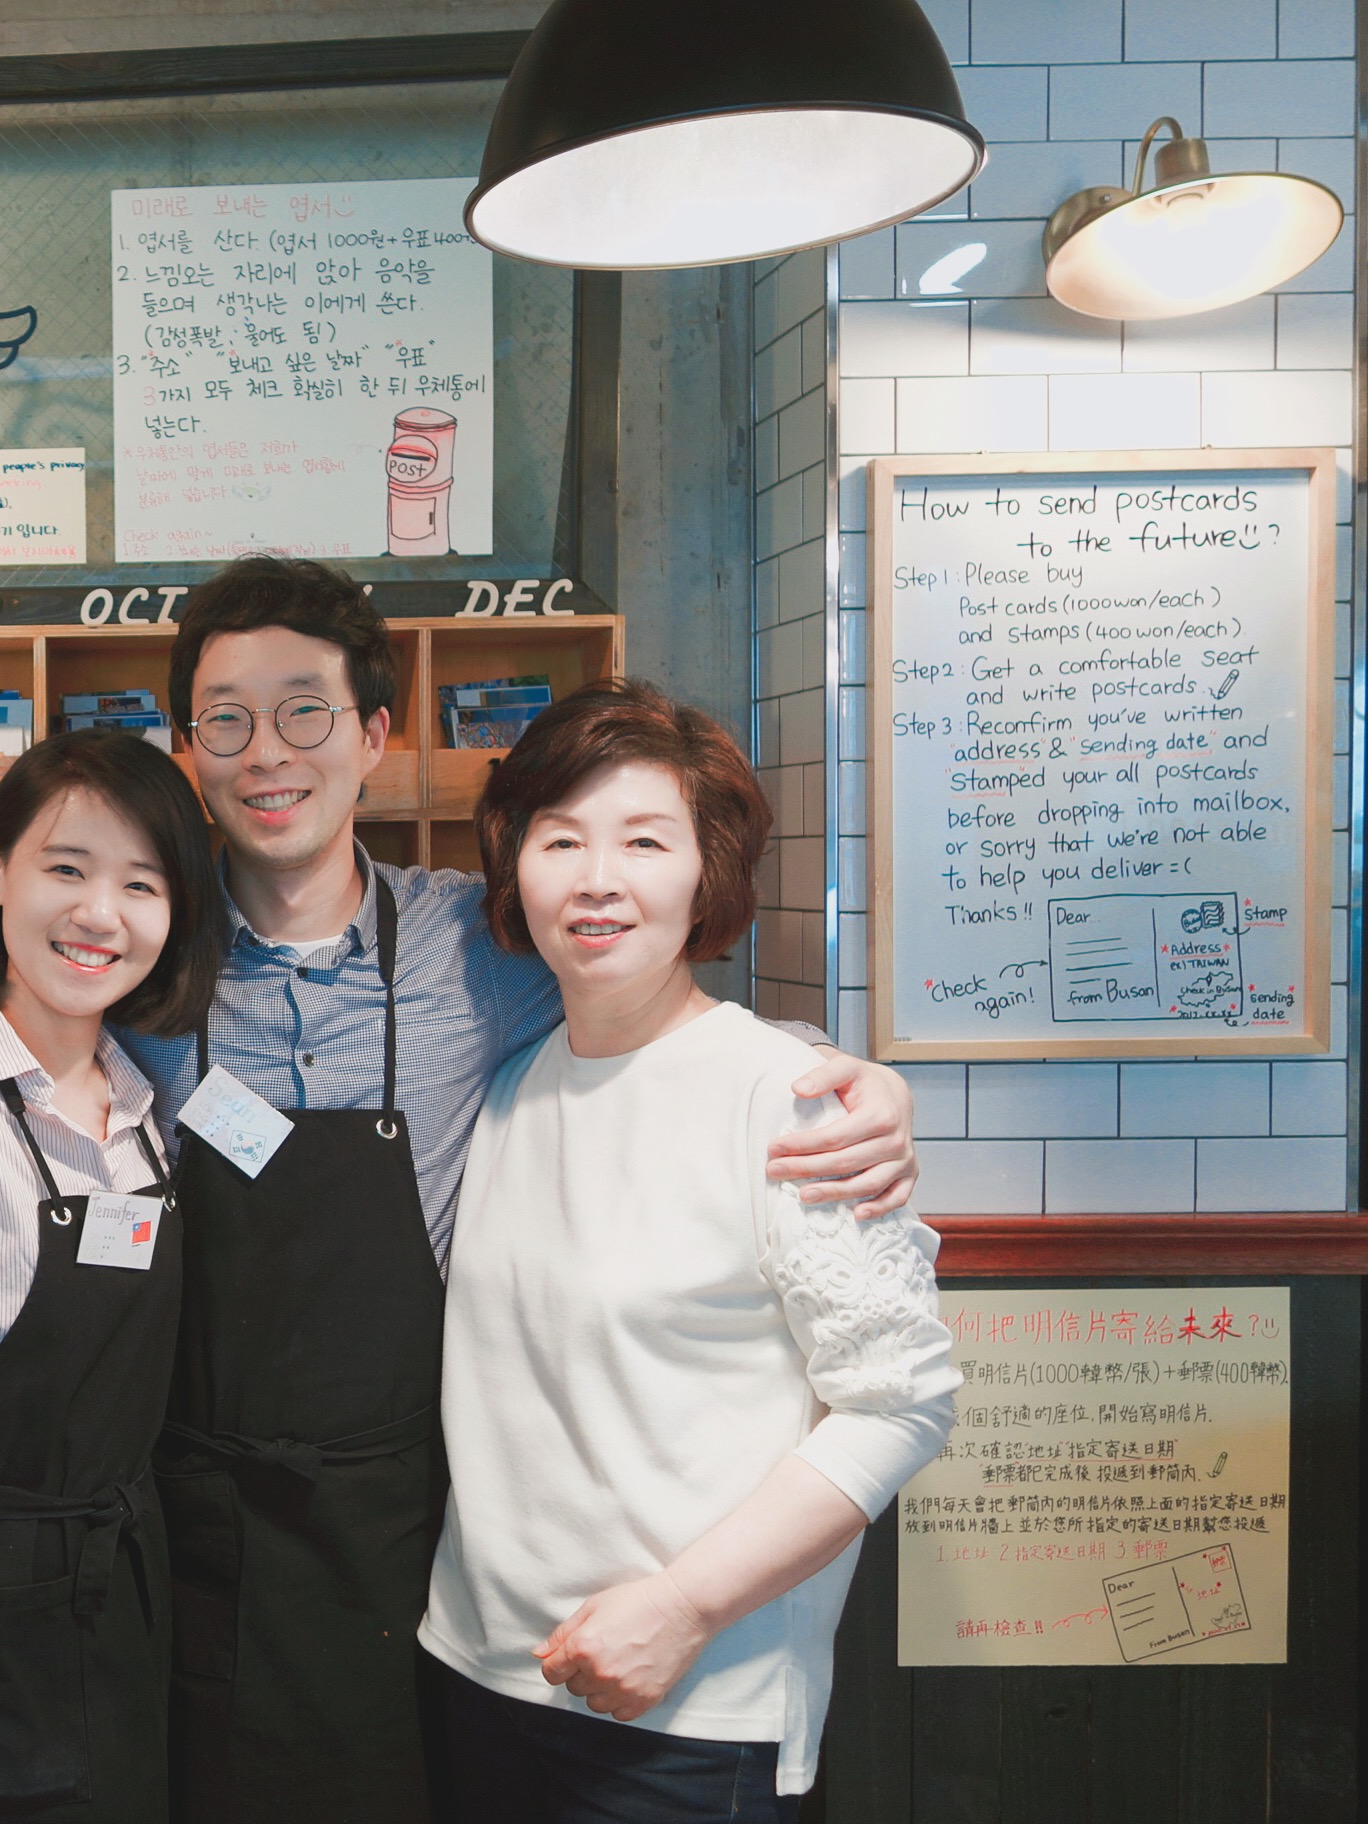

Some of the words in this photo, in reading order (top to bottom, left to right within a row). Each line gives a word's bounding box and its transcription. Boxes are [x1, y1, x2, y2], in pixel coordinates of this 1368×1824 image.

[133, 195, 193, 218] 미래로
[213, 194, 268, 217] 보내는
[289, 193, 331, 222] 엽서
[137, 230, 192, 255] 엽서를
[234, 262, 296, 285] 자리에
[316, 257, 362, 285] 앉아
[375, 258, 435, 284] 음악을
[142, 292, 195, 317] 들으며
[217, 292, 287, 316] 생각나는
[304, 292, 365, 314] 이에게
[286, 352, 316, 372] 싶은
[204, 378, 232, 400] 모두
[246, 378, 283, 398] 체크
[293, 374, 343, 399] 확실히
[359, 375, 380, 396] 한
[388, 378, 406, 395] 뒤
[415, 374, 485, 401] 우체통에
[900, 487, 969, 522] How
[985, 488, 1021, 516] to
[1038, 485, 1097, 515] send
[1115, 485, 1258, 523] postcards
[1016, 532, 1053, 558] to
[1068, 529, 1112, 554] the
[1129, 521, 1235, 553] future
[964, 562, 1030, 585] Please
[1047, 563, 1083, 588] buy
[79, 586, 189, 626] OCT
[455, 579, 577, 619] DEC
[958, 626, 992, 644] and
[972, 657, 1014, 680] Get
[1029, 663, 1043, 676] a
[1059, 648, 1181, 674] comfortable
[1201, 647, 1259, 667] seat
[966, 685, 1003, 705] and
[1023, 681, 1075, 702] write
[967, 711, 1072, 735] Reconfirm
[1088, 710, 1146, 735] you've
[1164, 706, 1243, 722] written
[1048, 737, 1068, 756] &
[1224, 726, 1268, 749] and
[1063, 768, 1107, 794] your
[1116, 761, 1139, 784] all
[1156, 764, 1258, 791] postcards
[948, 806, 1015, 829] before
[1037, 802, 1123, 825] dropping
[1138, 797, 1177, 814] into
[1193, 793, 1290, 813] mailbox,
[945, 840, 968, 856] or
[980, 838, 1036, 859] sorry
[1049, 831, 1093, 853] that
[1107, 831, 1158, 847] we're
[1173, 827, 1209, 842] not
[1221, 825, 1267, 842] able
[942, 869, 967, 892] to
[979, 864, 1025, 894] help
[1043, 865, 1080, 888] you
[1091, 861, 1160, 880] deliver
[1172, 942, 1221, 956] Address
[1188, 958, 1229, 968] TAIWAN
[932, 974, 987, 1002] Check
[1067, 990, 1103, 1006] from
[1105, 978, 1155, 1002] Busan
[975, 987, 1035, 1019] again!
[1253, 1008, 1285, 1019] date
[89, 1196, 139, 1225] Jennifer
[1108, 1581, 1134, 1593] Dear
[1168, 1629, 1190, 1642] Busan
